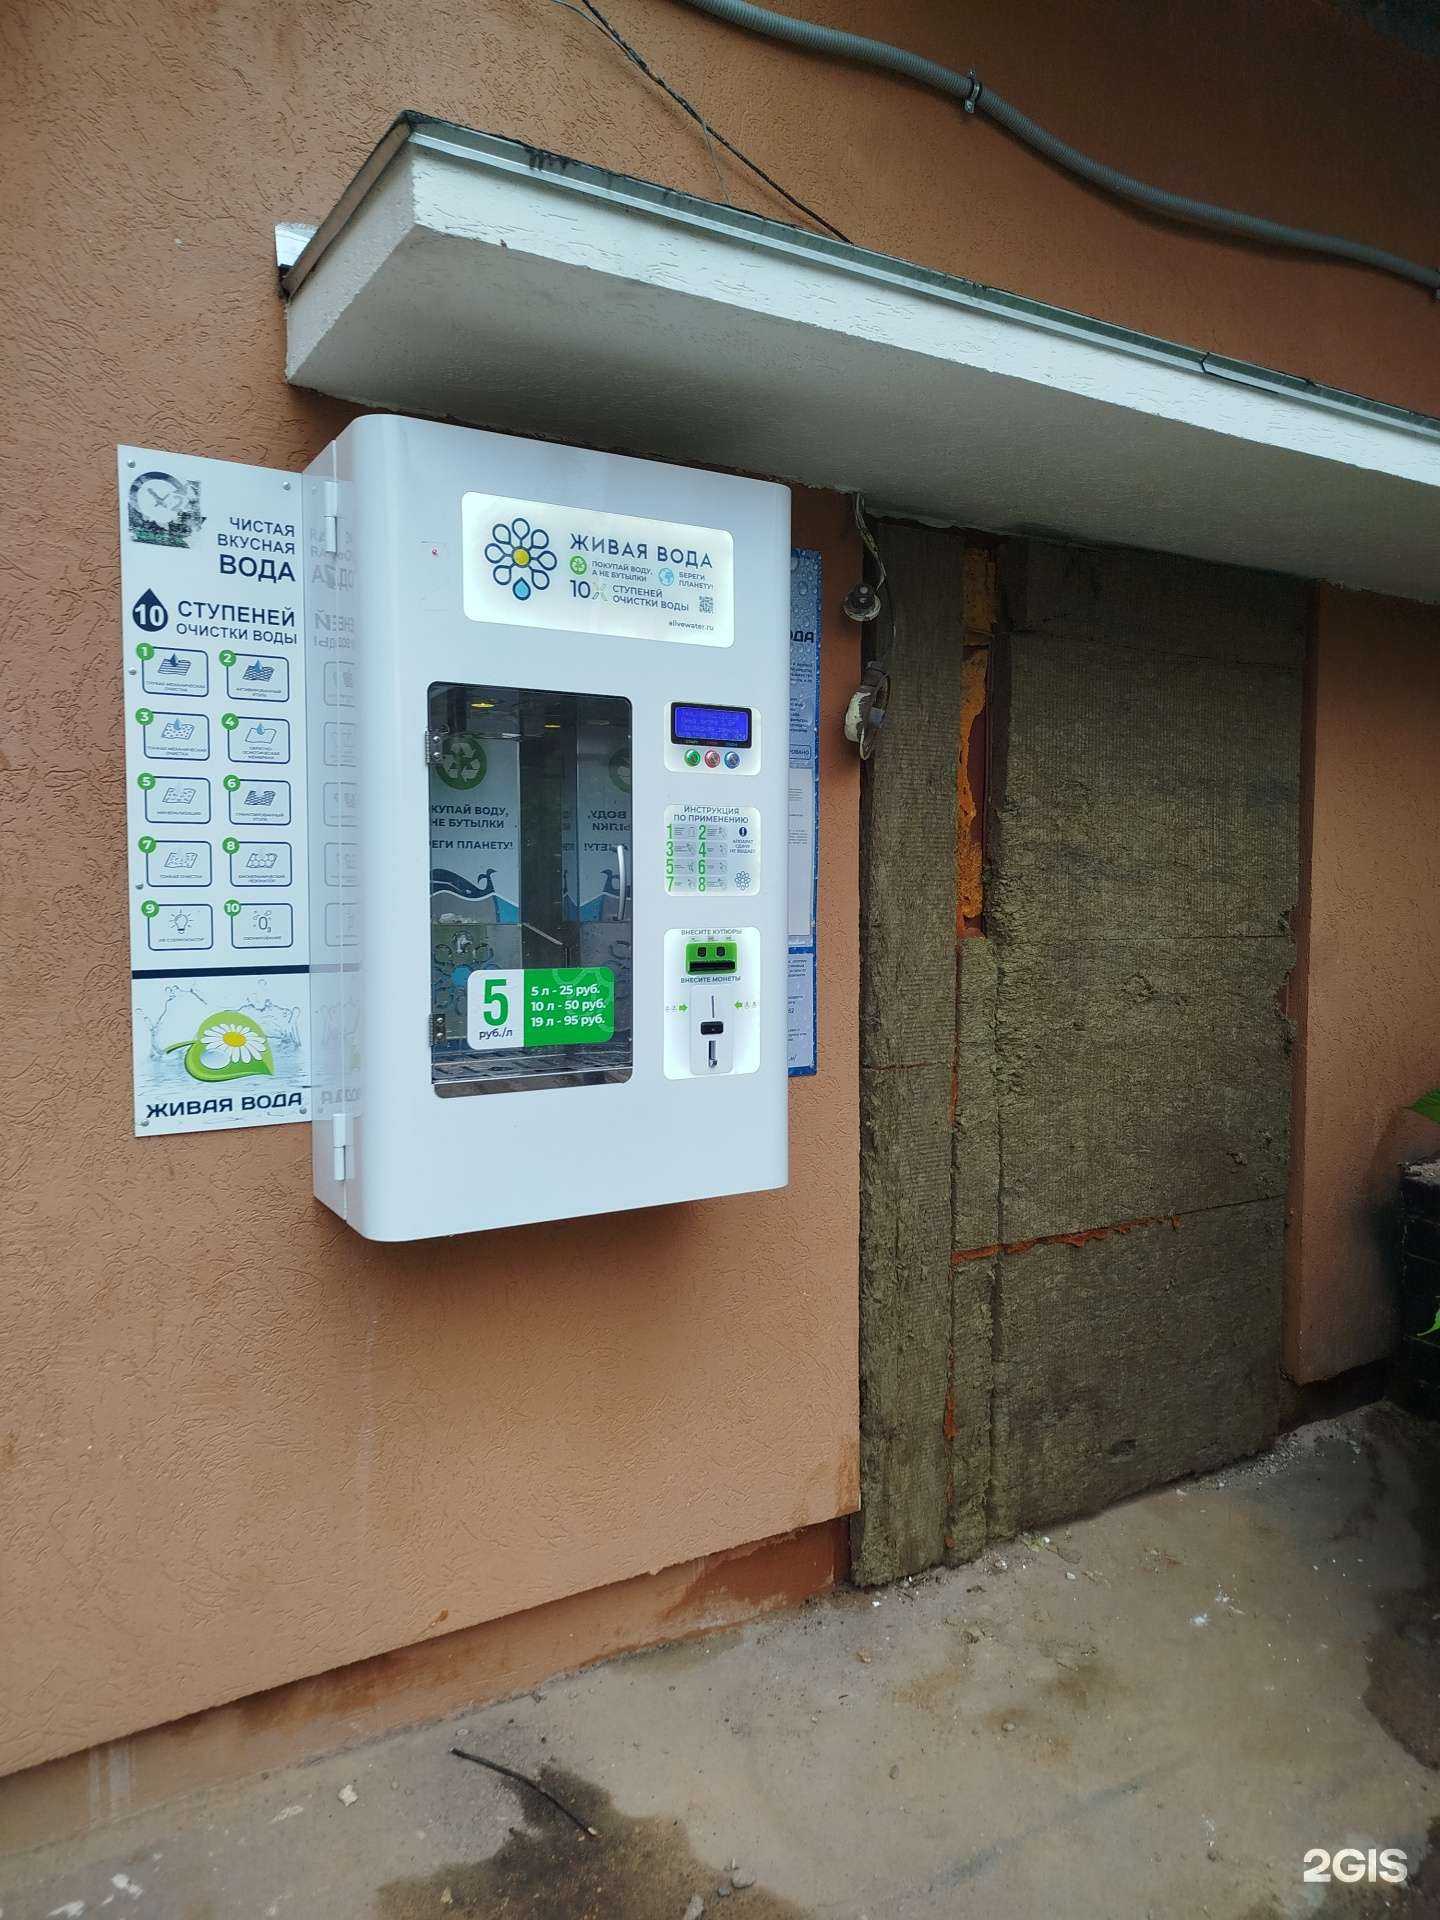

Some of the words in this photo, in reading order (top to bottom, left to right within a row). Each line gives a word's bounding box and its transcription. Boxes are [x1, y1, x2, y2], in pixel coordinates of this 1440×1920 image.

[229, 516, 295, 538] ЧИСТАЯ
[217, 533, 295, 555] ВКУСНАЯ
[570, 533, 648, 560] ЖИВАЯ
[657, 546, 713, 569] ВОДА
[219, 554, 296, 584] ВОДА
[591, 560, 629, 572] ПОКУПАЙ
[630, 566, 653, 576] ВОДУ,
[679, 571, 705, 581] БЕРЕГИ
[611, 571, 647, 582] БУТЫЛКИ
[570, 579, 591, 599] 10
[612, 584, 664, 598] СТУПЕНЕЙ
[613, 594, 658, 608] ОЧИСТКИ
[660, 601, 689, 611] ВОДЫ
[135, 603, 165, 627] 10
[178, 600, 295, 627] СТУПЕНЕЙ
[176, 623, 248, 640] ОЧИСТКИ
[253, 630, 297, 645] ВОДЫ
[474, 806, 510, 818] ВОДУ,
[673, 814, 687, 823] ПО
[688, 814, 749, 824] ПРИМЕНЕНИЮ
[683, 806, 740, 816] ИНСТРУКЦИЯ
[448, 818, 505, 829] БУТЫЛКИ
[666, 823, 673, 839] 1
[698, 825, 707, 840] 2
[430, 839, 453, 849] ЕГИ
[457, 840, 514, 850] ПЛАНЕТУ!
[665, 841, 673, 857] 3
[698, 842, 707, 858] 4
[665, 858, 673, 874] 5
[698, 859, 706, 875] 6
[665, 876, 674, 892] 7
[698, 876, 706, 892] 8
[226, 903, 239, 913] 10
[531, 986, 538, 996] 5
[541, 987, 549, 996] л
[560, 985, 573, 995] 25
[576, 983, 600, 997] руб.
[483, 978, 509, 1027] 5
[531, 1001, 544, 1011] 10
[546, 1002, 554, 1011] л
[564, 1000, 579, 1010] 50
[582, 998, 606, 1012] руб.
[531, 1017, 543, 1027] 19
[546, 1018, 554, 1027] л
[564, 1015, 578, 1026] 95
[581, 1014, 605, 1027] руб.
[479, 1027, 513, 1040] руб./л
[146, 1098, 233, 1119] ЖИВАЯ
[241, 1092, 301, 1111] ВОДА
